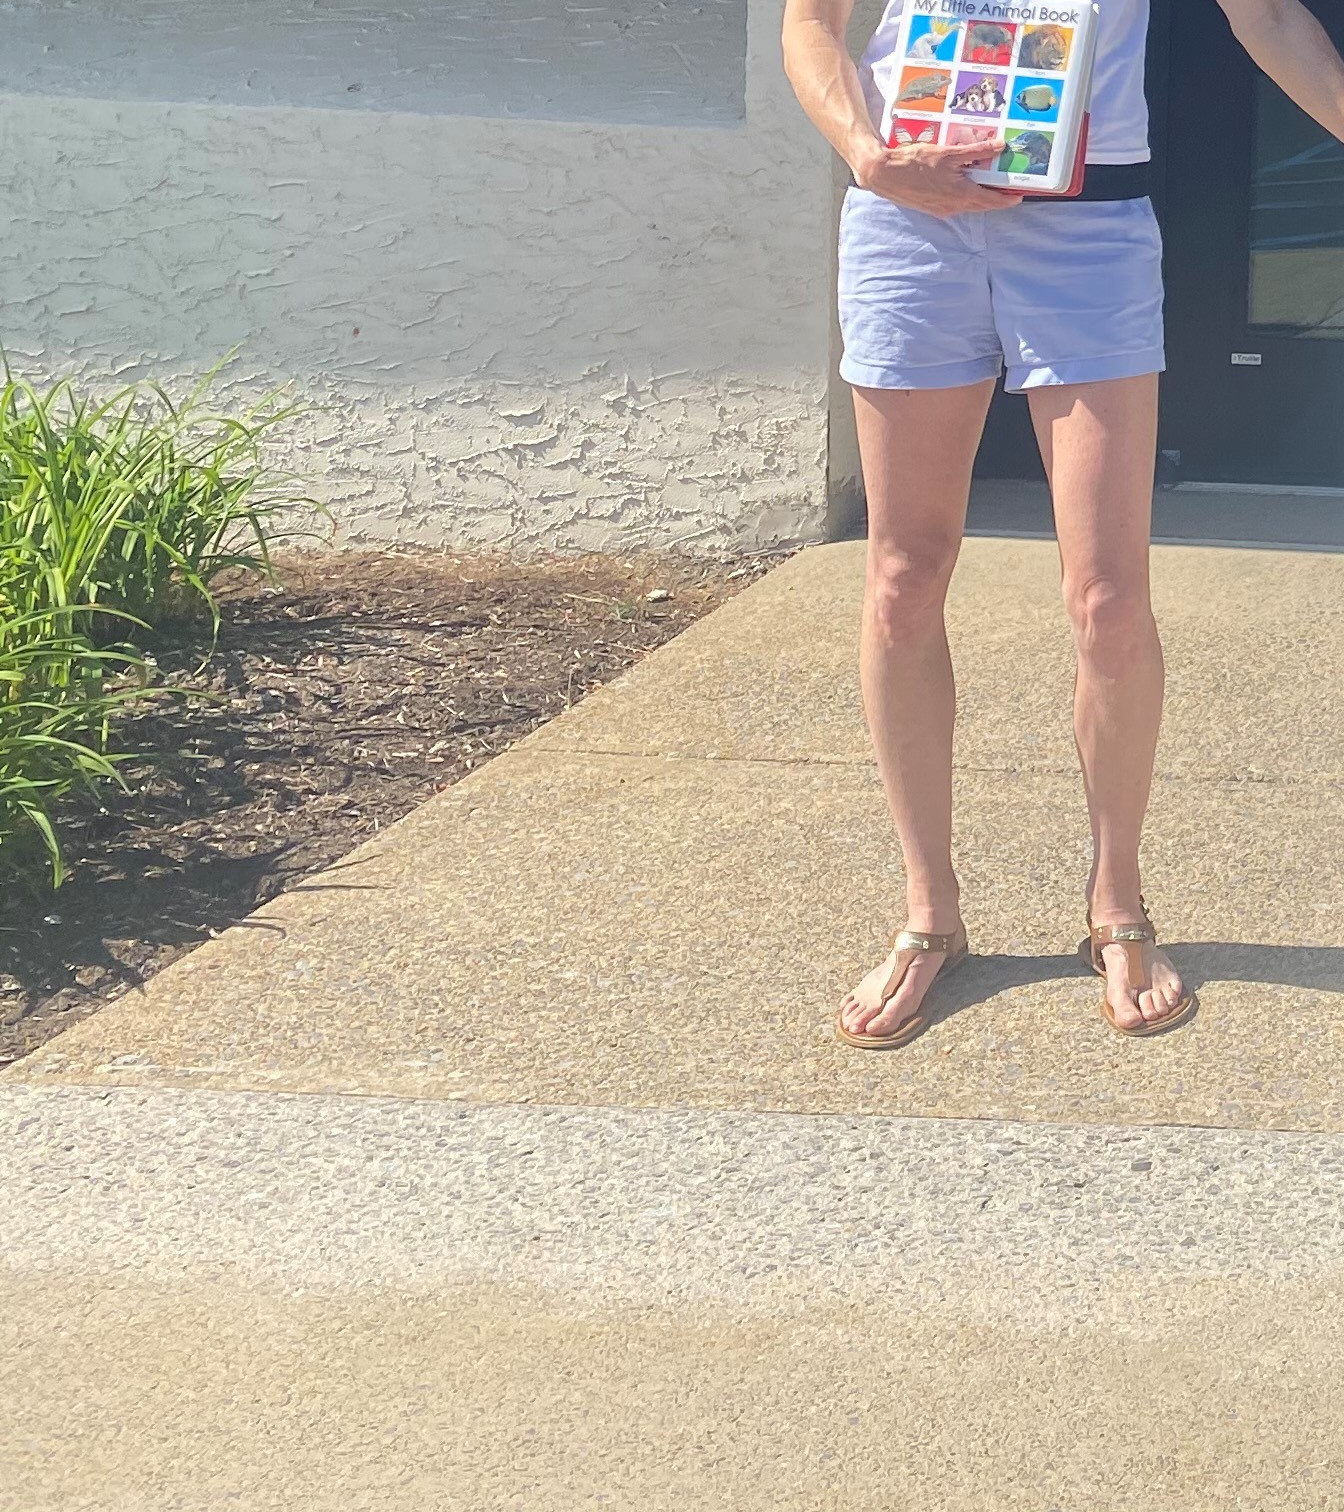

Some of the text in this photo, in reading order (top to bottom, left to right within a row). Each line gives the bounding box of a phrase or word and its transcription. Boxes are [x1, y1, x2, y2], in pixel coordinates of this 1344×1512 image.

[941, 0, 975, 15] Little
[979, 3, 1035, 20] Animal
[1039, 7, 1080, 24] Book
